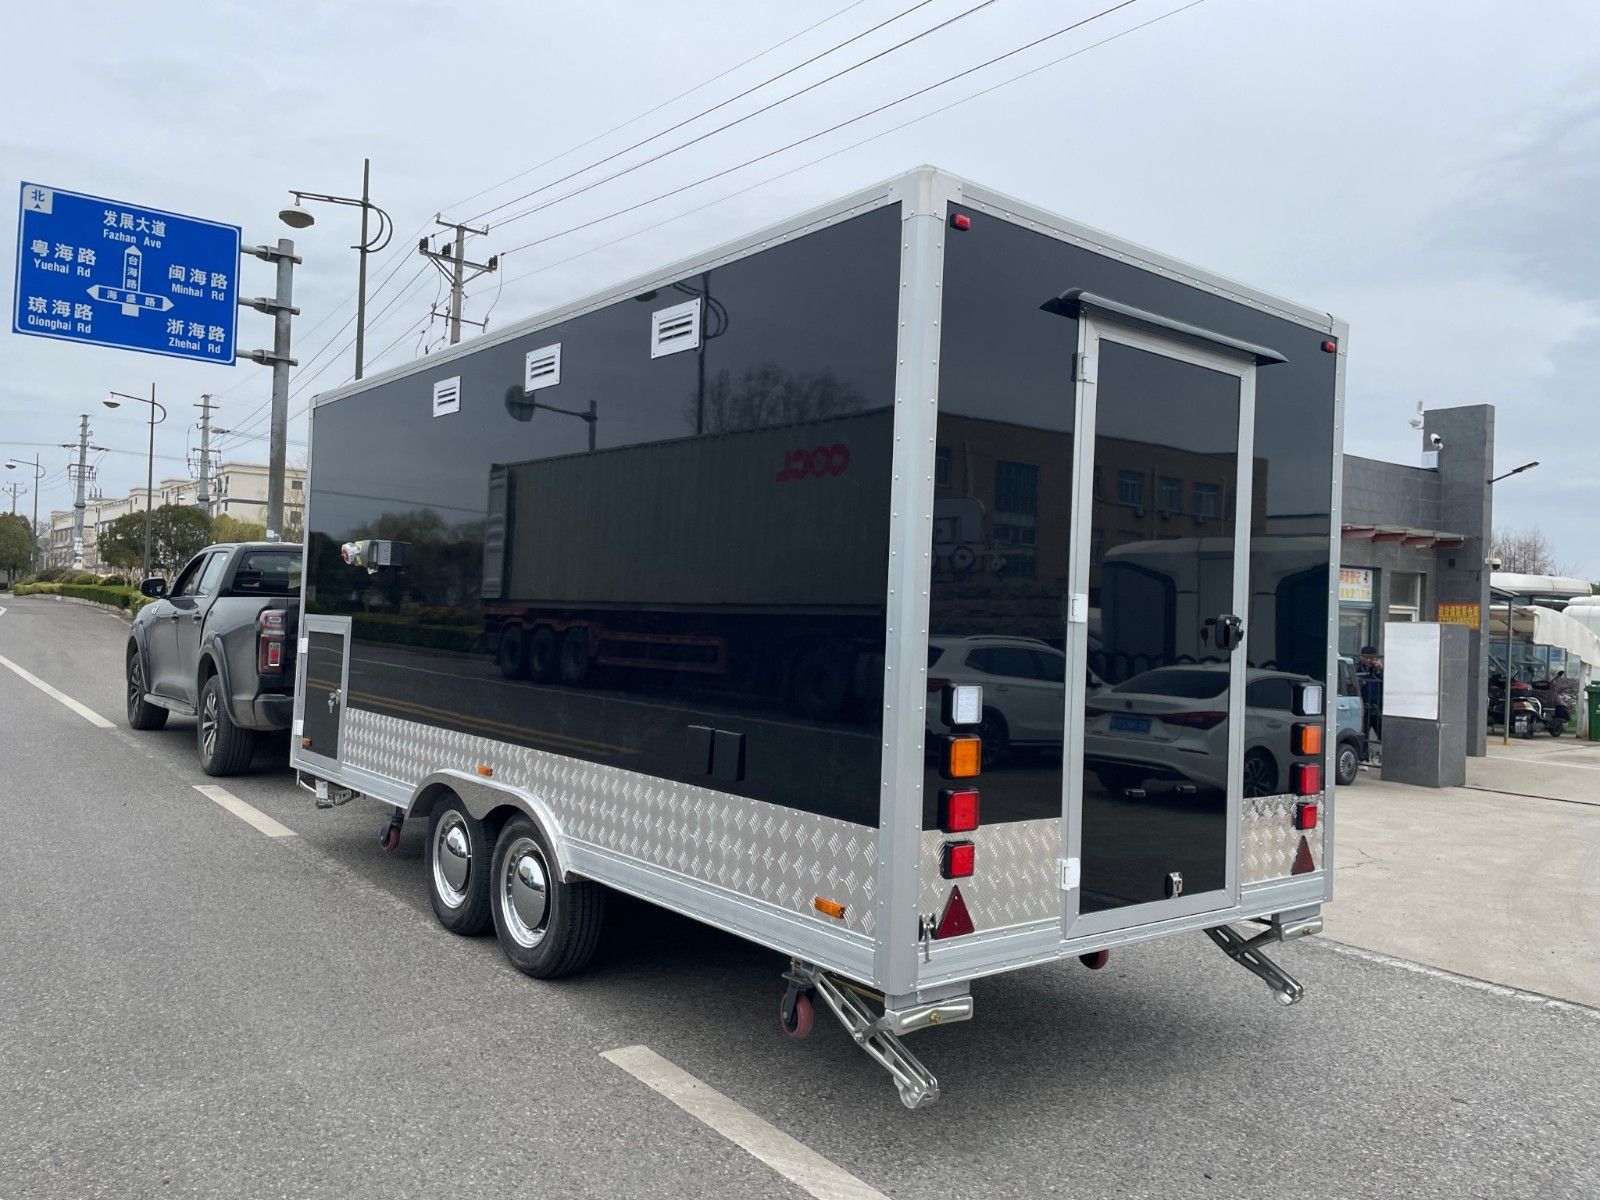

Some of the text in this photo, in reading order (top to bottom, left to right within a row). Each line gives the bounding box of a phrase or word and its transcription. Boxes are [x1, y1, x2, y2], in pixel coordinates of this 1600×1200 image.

[31, 189, 45, 201] 北
[104, 210, 166, 237] 发展大道
[103, 229, 162, 249] Fazhan Ave
[31, 240, 96, 266] 粤海路
[34, 258, 91, 278] Yuehai Rd
[127, 256, 138, 289] 台海路
[169, 264, 227, 290] 闽海路
[107, 290, 155, 307] 海盛路
[171, 283, 225, 301] Minhai Rd
[28, 296, 93, 321] 琼海路
[28, 315, 92, 334] Qionghai Rd
[167, 319, 225, 343] 浙海路
[169, 338, 221, 354] Zhehai Rd
